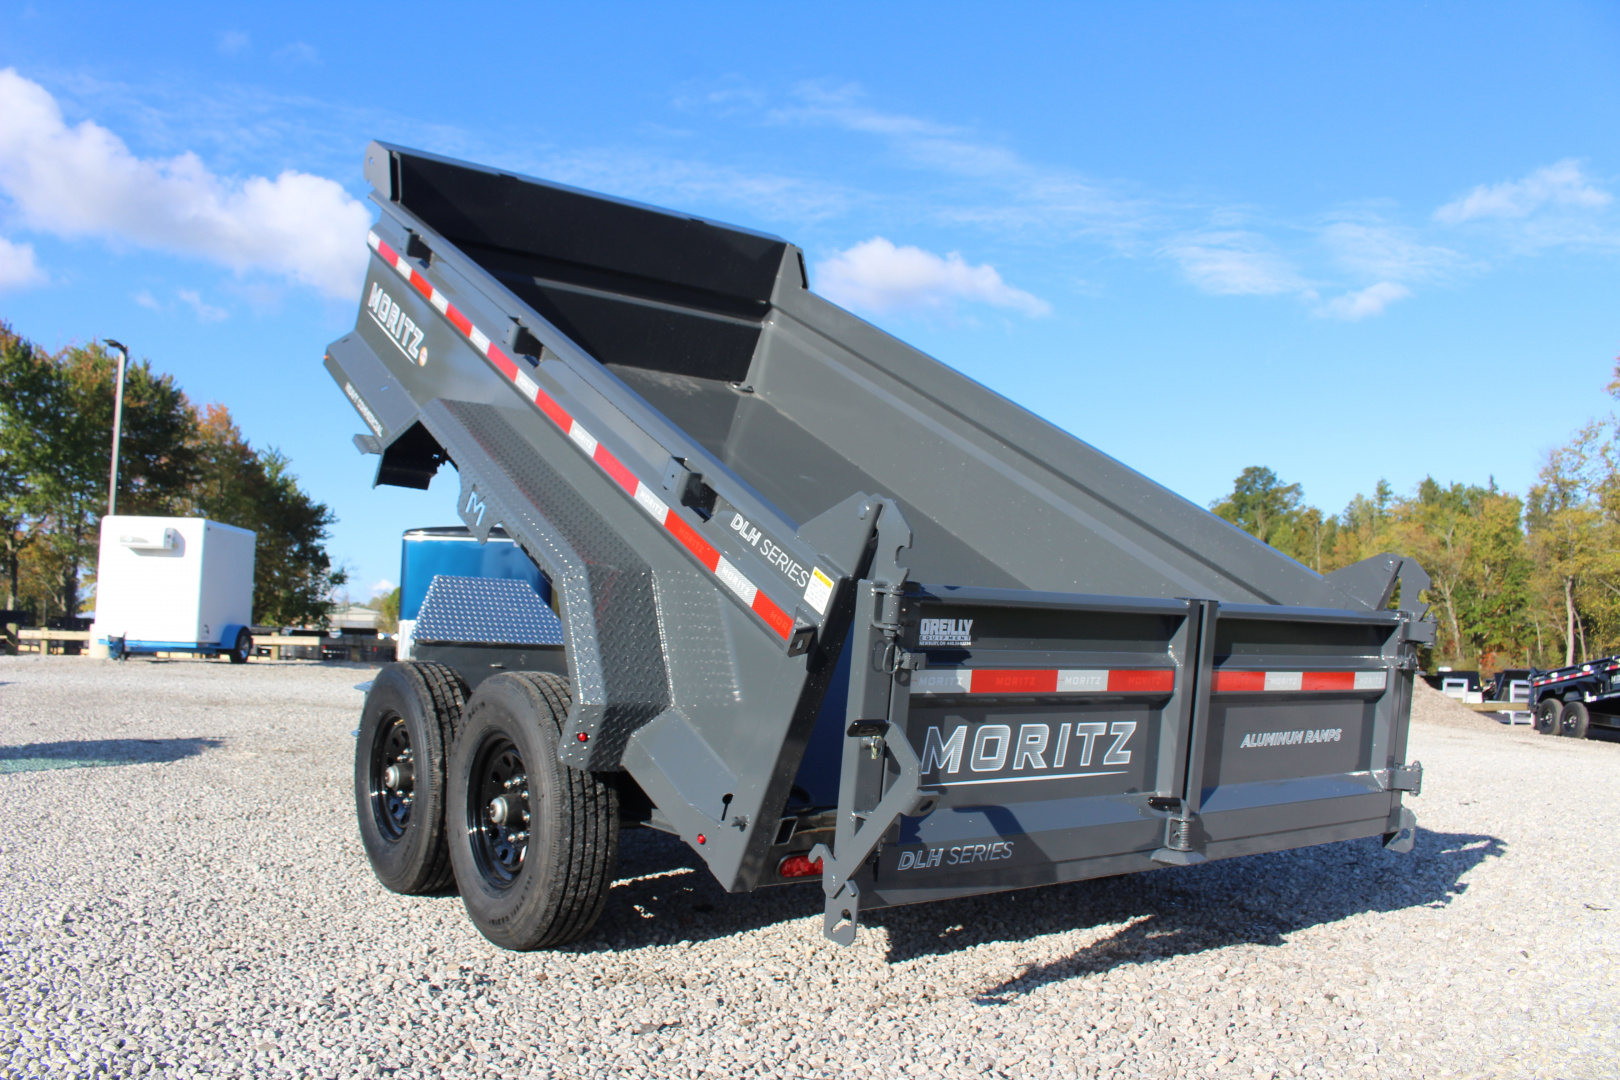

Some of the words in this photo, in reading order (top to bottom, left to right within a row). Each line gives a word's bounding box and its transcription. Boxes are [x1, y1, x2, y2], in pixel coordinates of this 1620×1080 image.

[368, 281, 424, 359] MORITZ
[639, 489, 664, 515] MORITZ
[679, 526, 705, 554] MORITZ
[730, 513, 761, 546] DLH
[759, 539, 809, 587] SERIES
[721, 566, 750, 597] MORITZ
[918, 676, 963, 686] MORITZ
[996, 677, 1036, 686] MORITZ
[1064, 676, 1101, 685] MORITZ
[1128, 677, 1162, 685] MORITZ
[921, 721, 1137, 775] MORITZ
[1240, 730, 1304, 748] ALUMINUM
[1304, 728, 1342, 743] RAMPS
[898, 848, 944, 870] DLH
[946, 841, 1014, 866] SERIES
